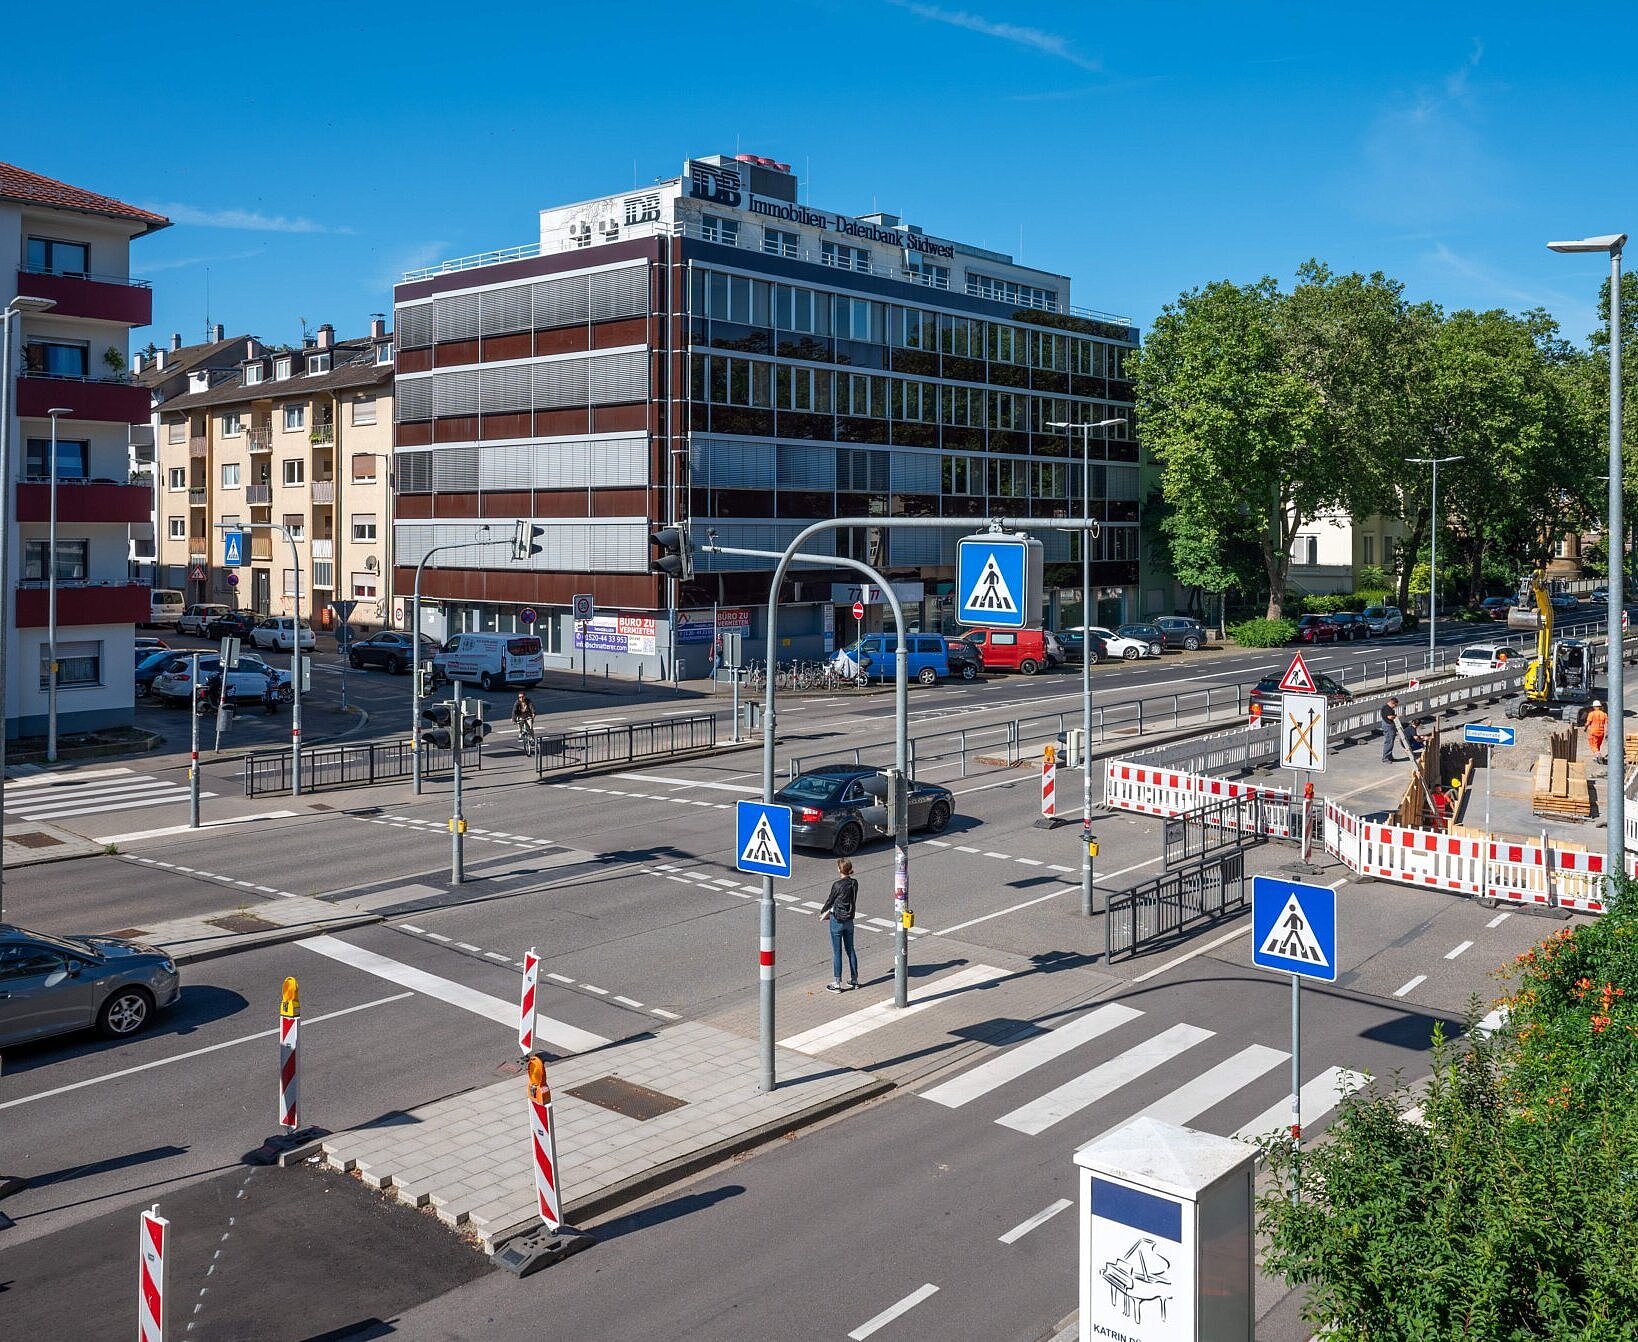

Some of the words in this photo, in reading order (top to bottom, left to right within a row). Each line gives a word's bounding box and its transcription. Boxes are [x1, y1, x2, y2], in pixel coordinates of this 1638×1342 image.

[689, 160, 742, 207] IDB
[623, 191, 661, 226] IDB
[748, 193, 904, 247] Immobilien-Datenbank
[906, 233, 955, 260] Südwest
[619, 615, 642, 627] BÜRO
[643, 618, 655, 628] ZU
[717, 611, 738, 620] BÜRO
[738, 612, 749, 620] ZU
[717, 619, 749, 627] VERMIETEN
[619, 626, 655, 635] VERMIETEN
[608, 635, 615, 643] 33
[617, 636, 628, 644] 953
[1093, 1323, 1127, 1342] KATRIN
